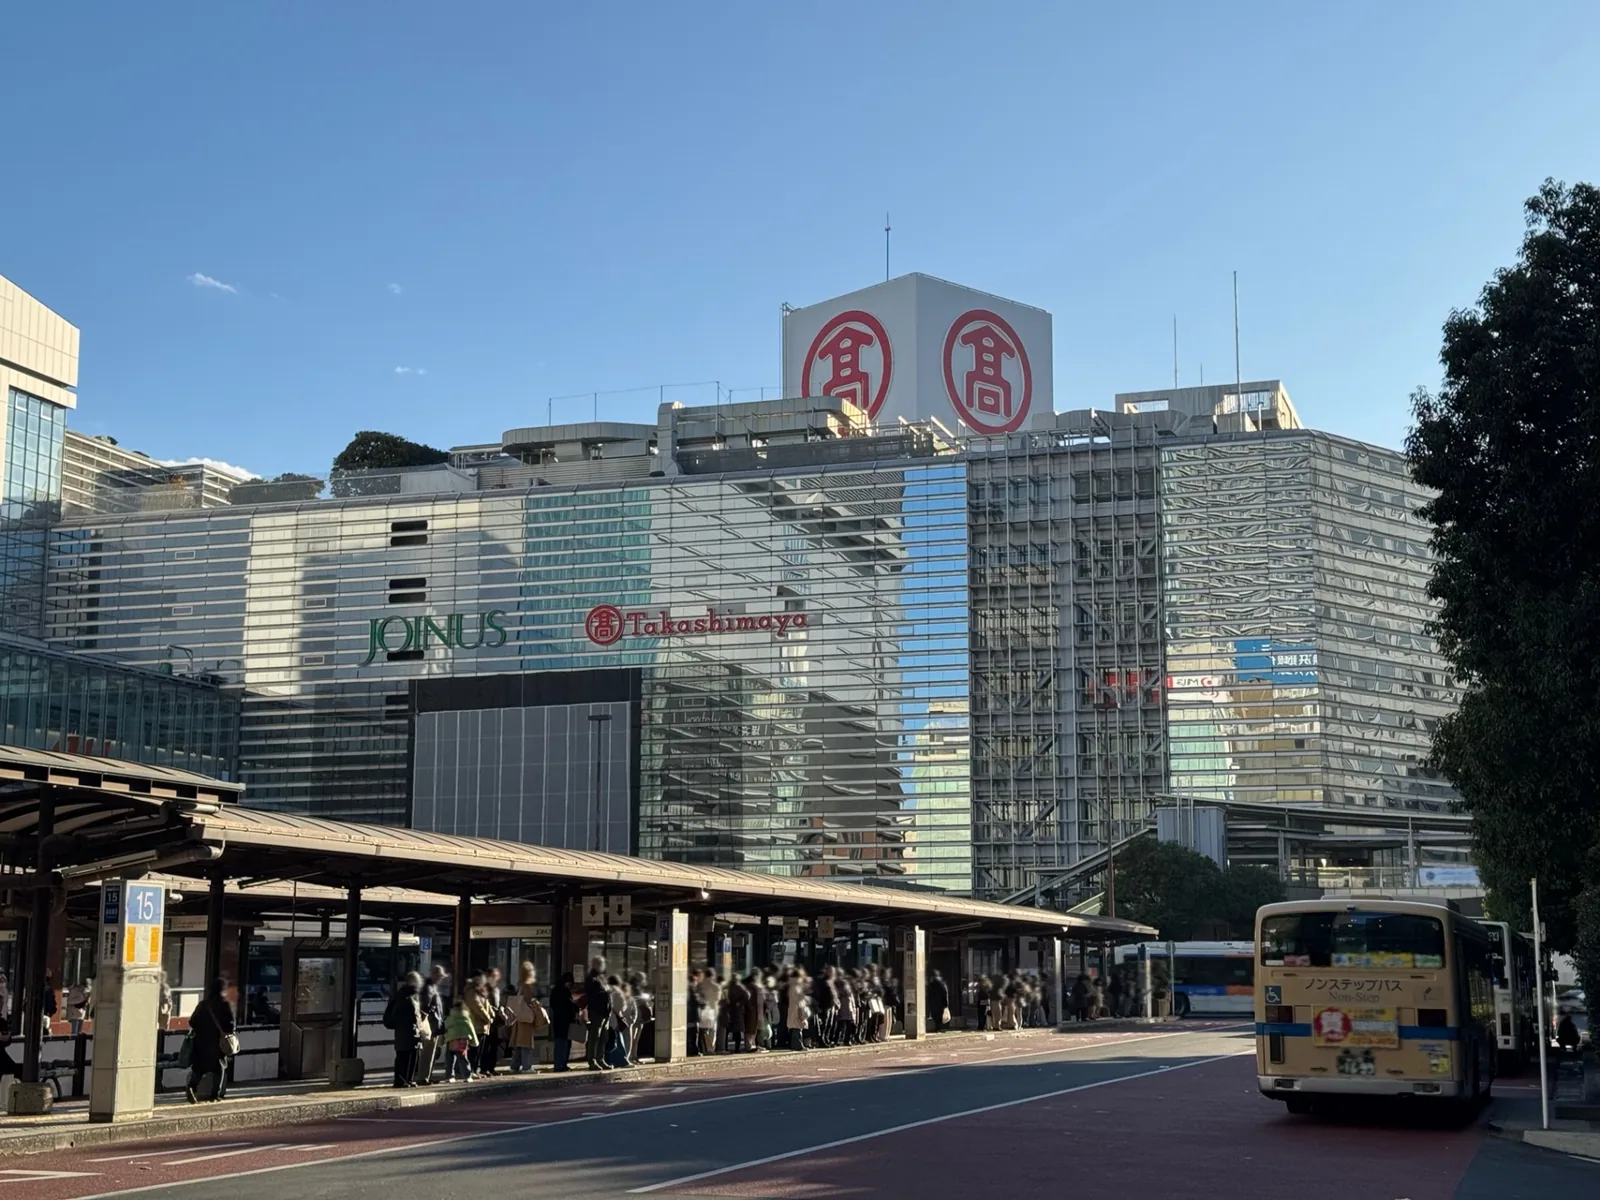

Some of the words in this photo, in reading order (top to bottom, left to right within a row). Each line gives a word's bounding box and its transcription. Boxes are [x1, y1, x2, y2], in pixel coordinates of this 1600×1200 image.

[626, 608, 808, 638] Takashimaya
[358, 610, 507, 666] JOINUS
[107, 892, 118, 903] 15
[136, 890, 154, 920] 15
[1304, 978, 1404, 992] ノンステップバス
[1329, 991, 1380, 1003] Non-Step
